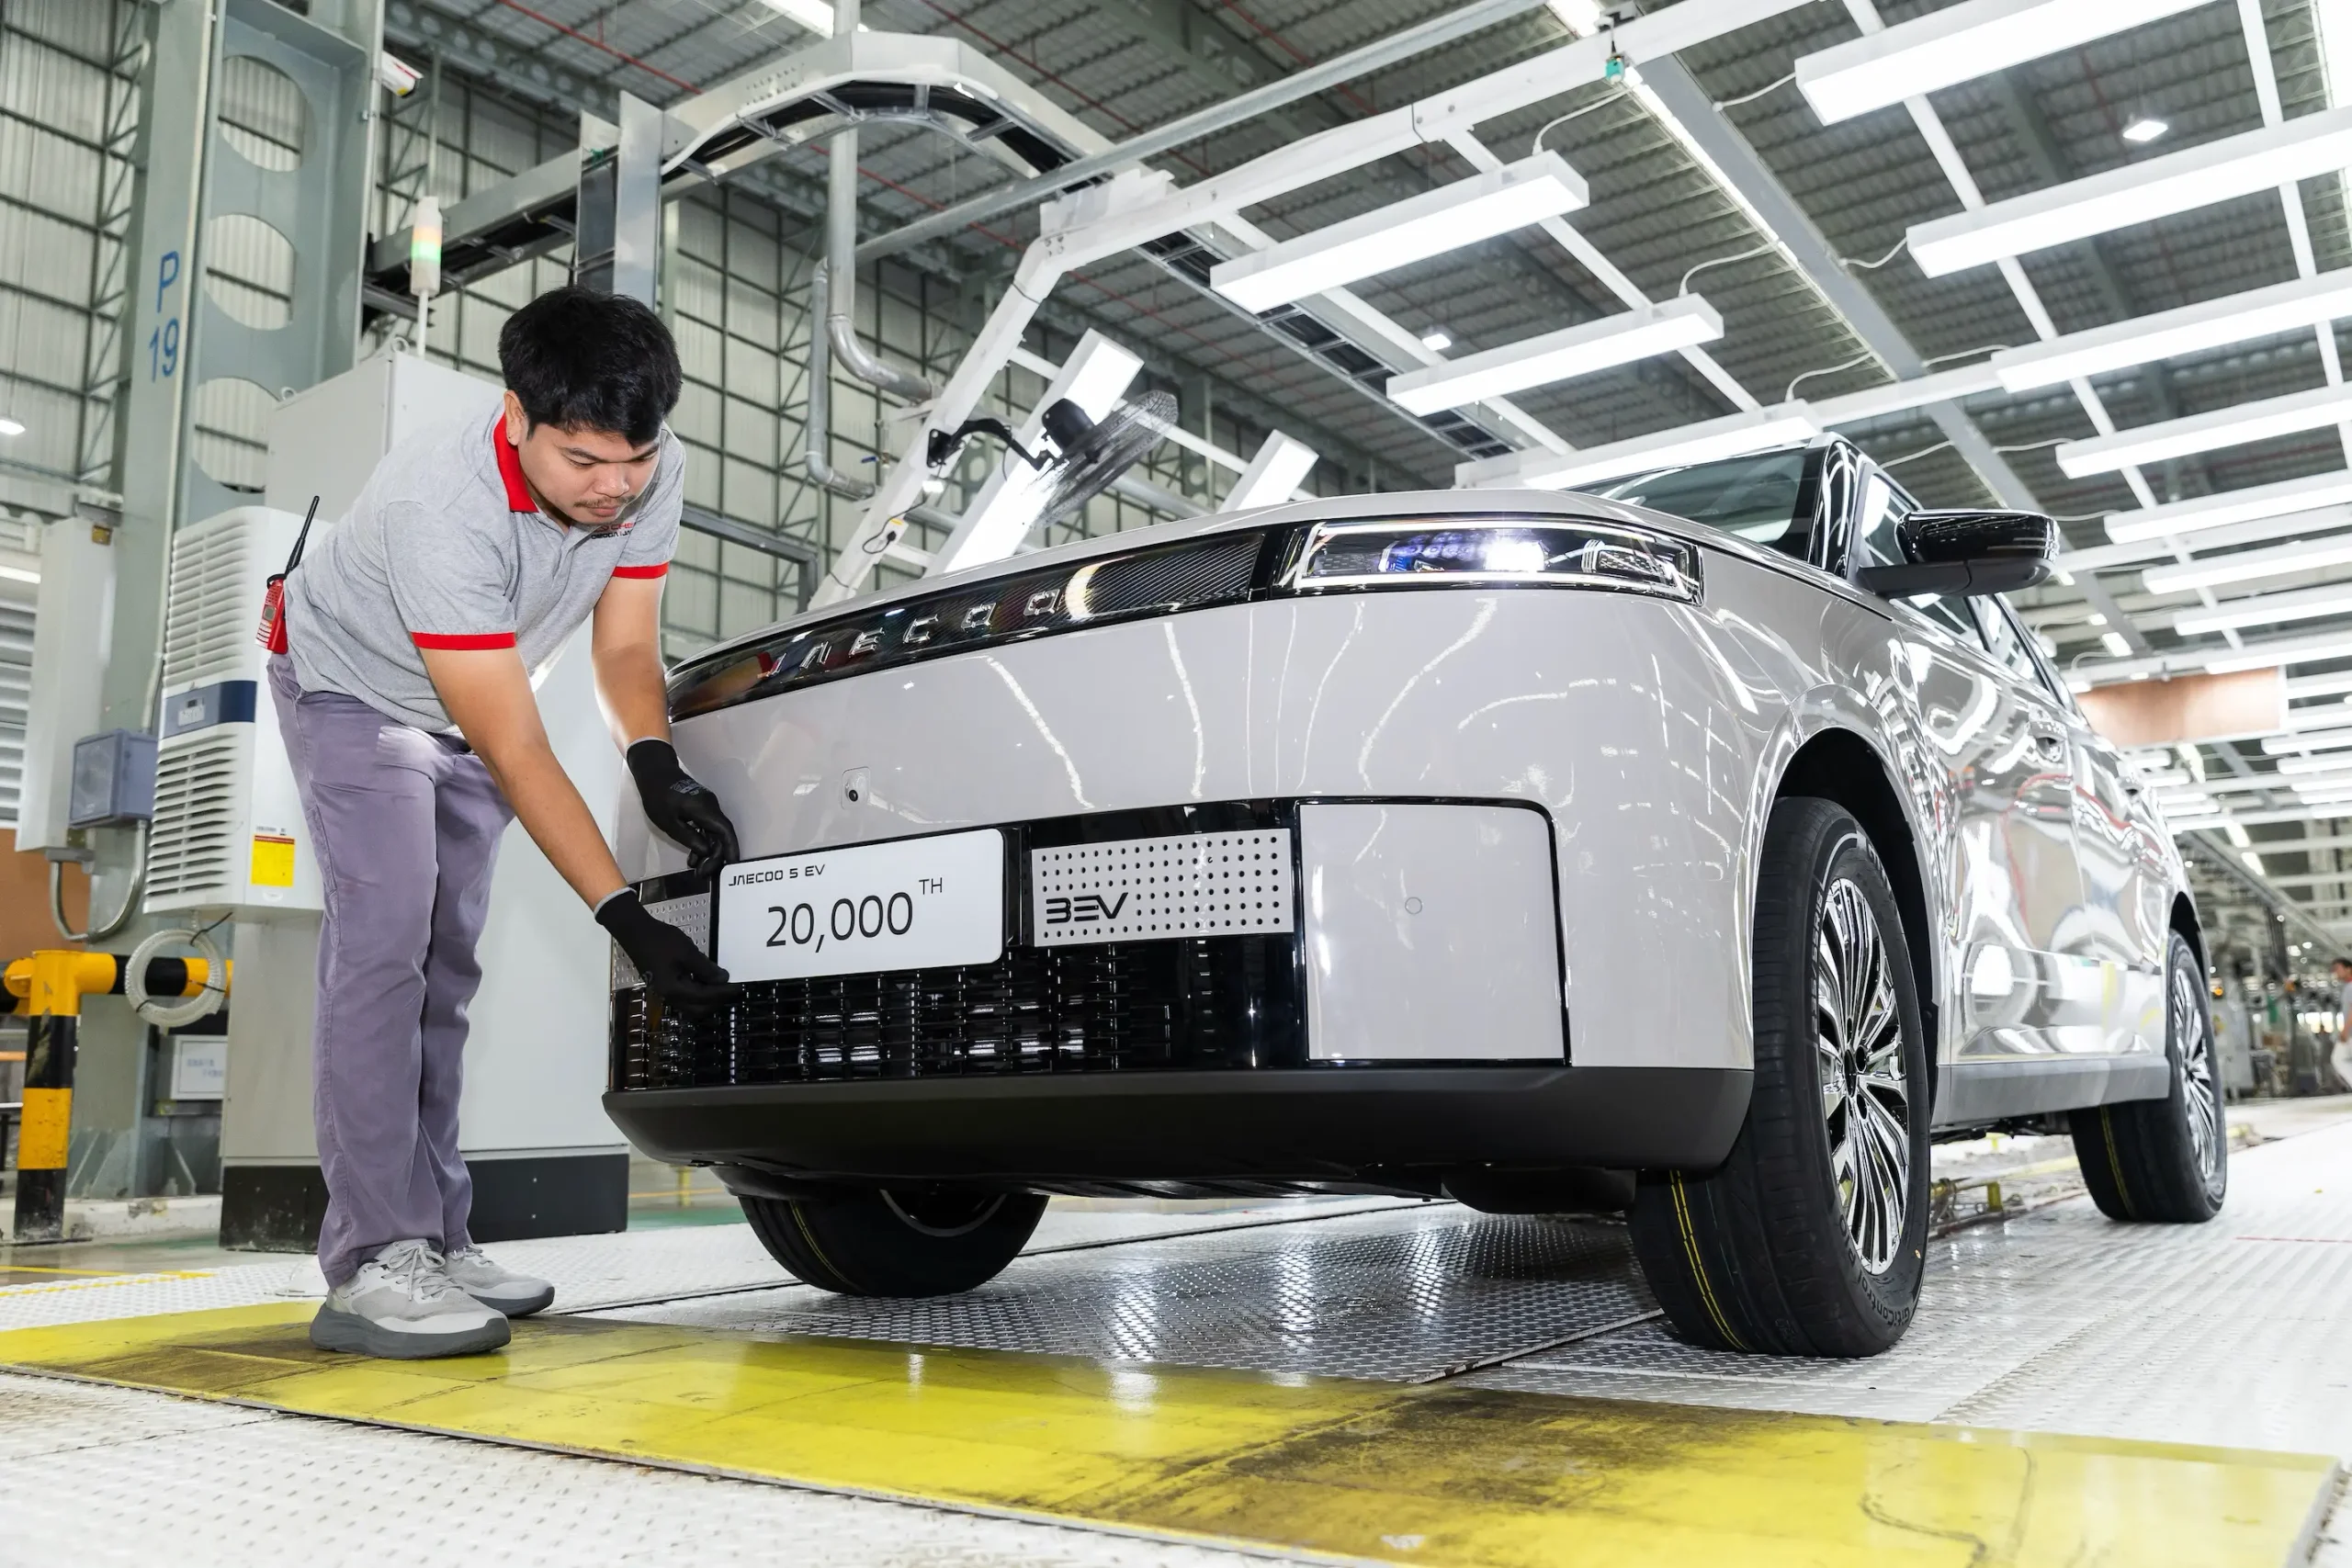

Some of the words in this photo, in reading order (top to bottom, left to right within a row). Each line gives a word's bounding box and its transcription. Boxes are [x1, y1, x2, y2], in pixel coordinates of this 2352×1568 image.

[156, 250, 179, 313] P
[149, 318, 179, 383] 19
[729, 870, 784, 886] JAECOO
[789, 868, 798, 879] 5
[805, 863, 826, 877] EV
[766, 891, 913, 953] 20,000
[919, 877, 943, 896] TH
[1046, 892, 1129, 924] BEV
